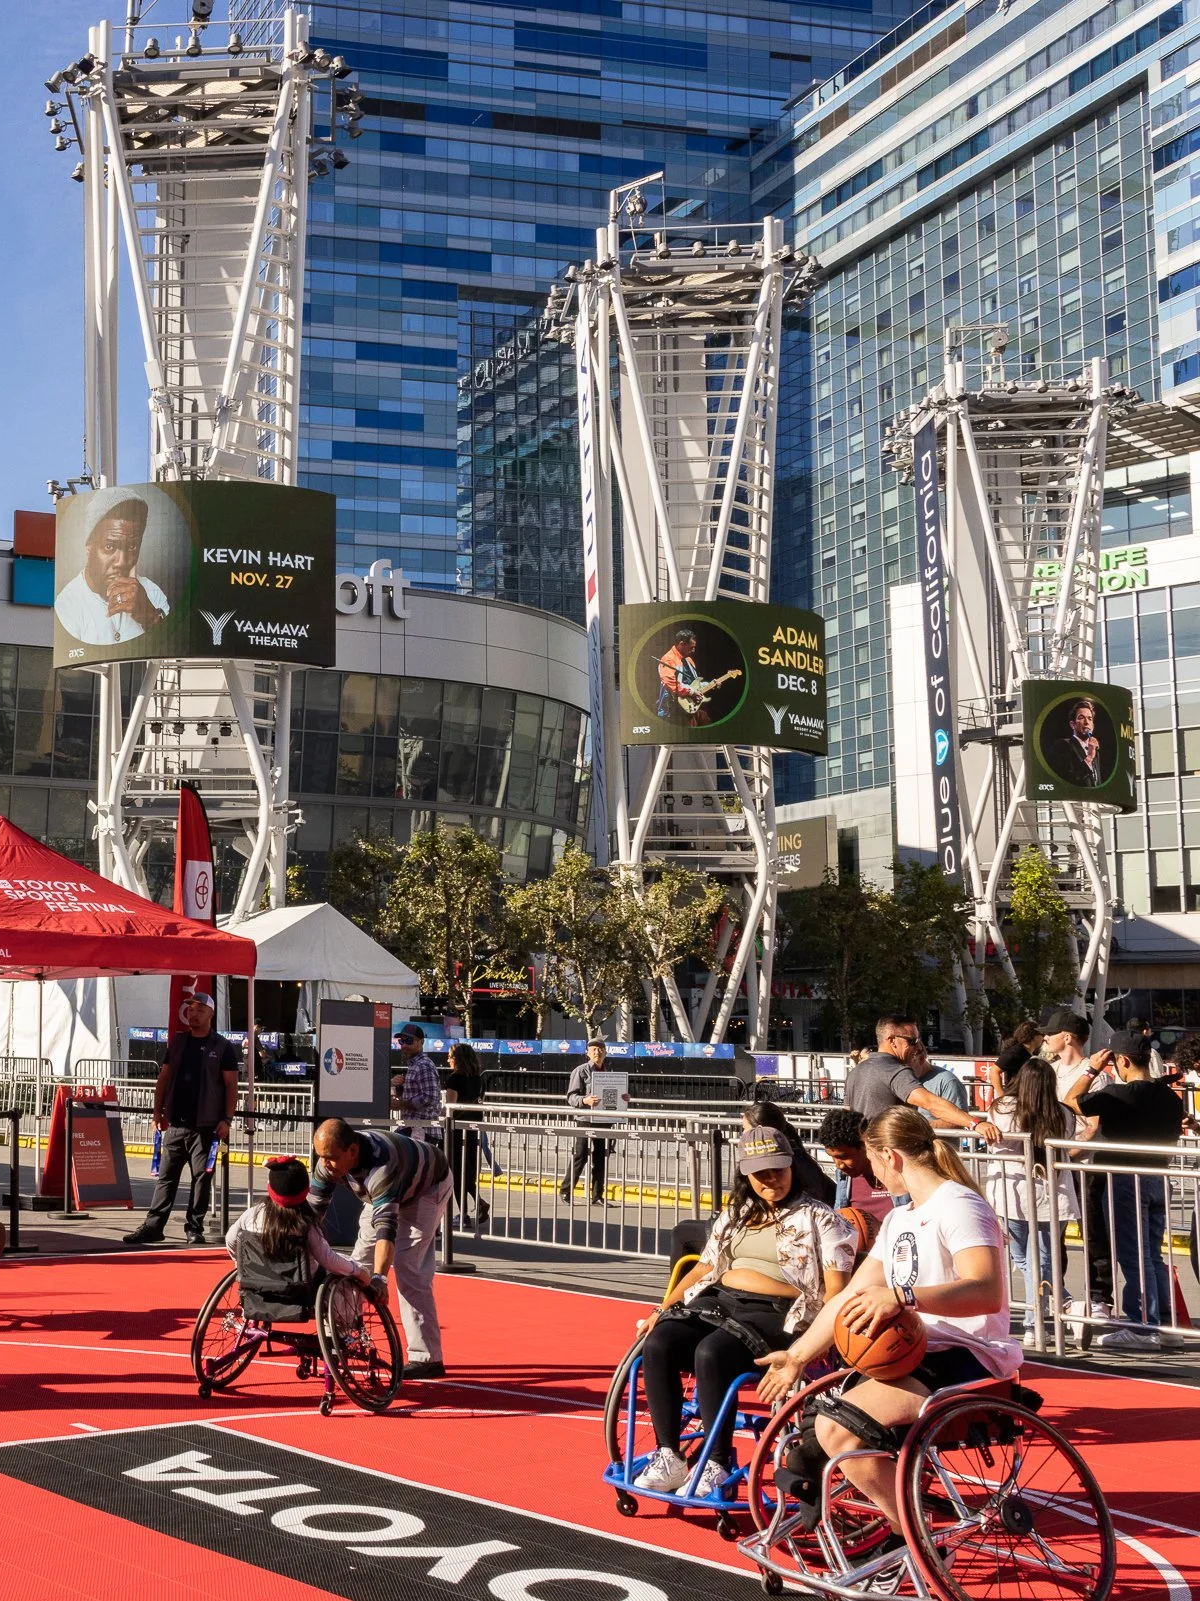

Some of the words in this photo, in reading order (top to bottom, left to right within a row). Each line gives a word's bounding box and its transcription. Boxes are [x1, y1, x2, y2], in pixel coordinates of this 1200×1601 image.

[203, 548, 262, 565] KEVIN
[268, 551, 315, 571] HART
[919, 450, 942, 659] california
[230, 571, 270, 588] NOV.
[275, 575, 294, 589] 27
[248, 635, 298, 649] THEATER
[772, 625, 819, 651] ADAM
[68, 648, 85, 658] axs
[758, 647, 825, 676] SANDLER
[777, 673, 809, 693] DEC.
[810, 681, 818, 696] 8
[930, 675, 945, 716] of
[632, 725, 651, 735] axs
[940, 776, 957, 876] blue
[3, 889, 79, 902] SPORTS
[13, 879, 96, 894] TOYOTA
[45, 901, 136, 914] FESTIVAL
